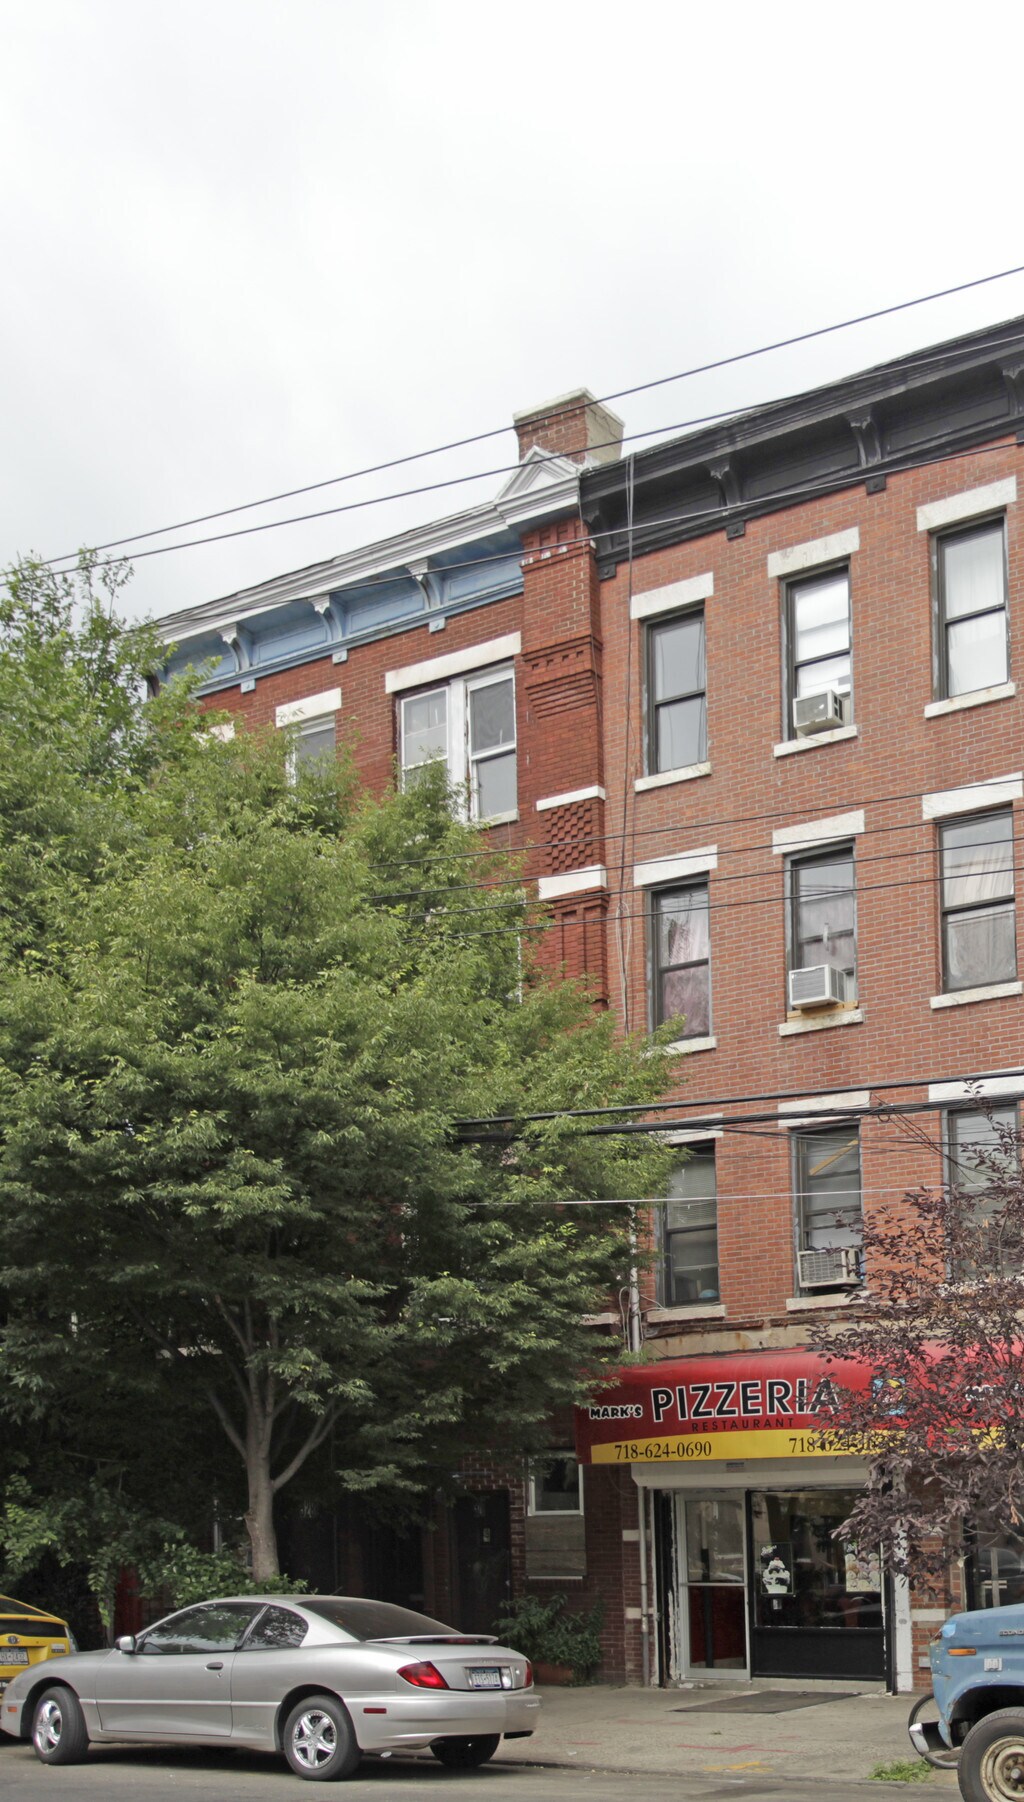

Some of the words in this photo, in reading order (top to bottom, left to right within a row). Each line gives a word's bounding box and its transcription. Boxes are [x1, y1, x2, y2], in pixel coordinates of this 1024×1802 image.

[588, 1404, 644, 1420] MARK'S
[650, 1378, 841, 1423] PIZZERIA
[691, 1417, 795, 1433] RESTAURANT
[613, 1440, 713, 1460] 718-624-0690
